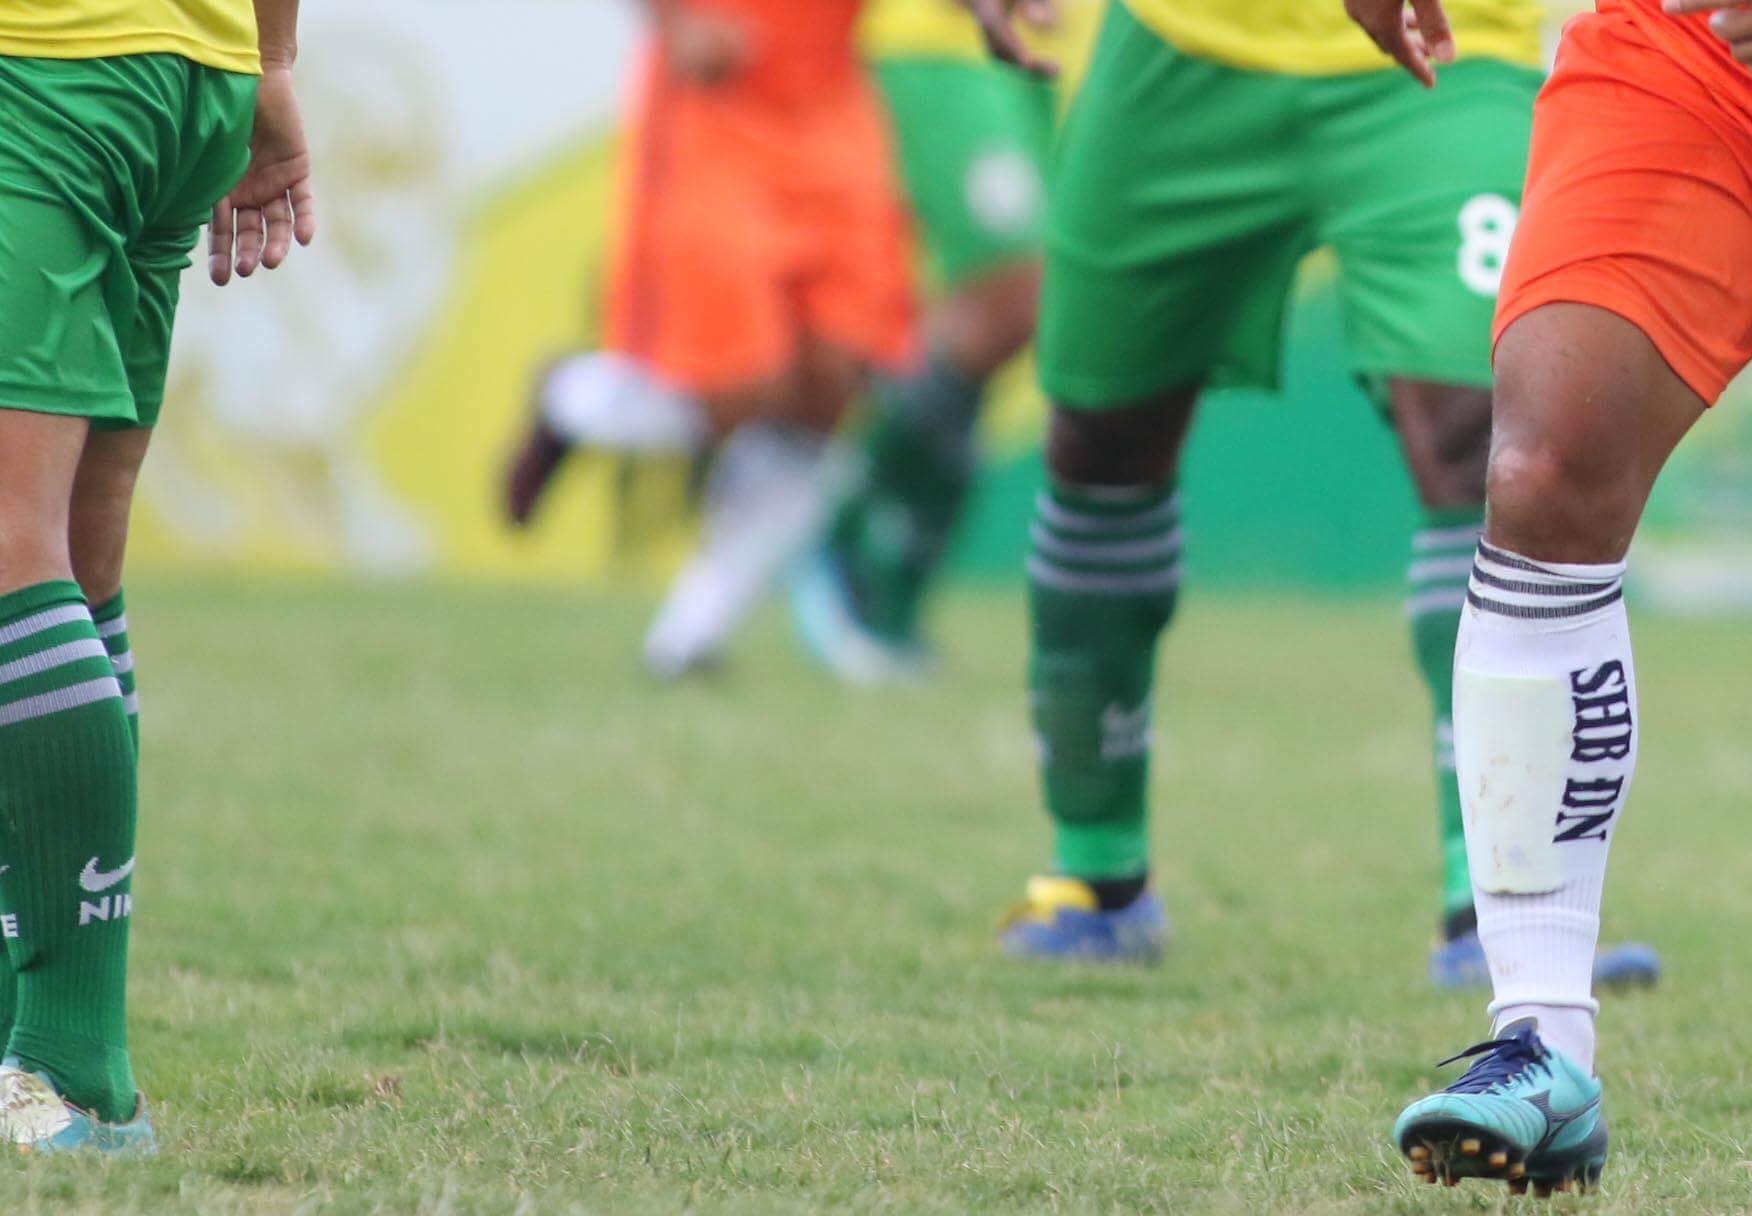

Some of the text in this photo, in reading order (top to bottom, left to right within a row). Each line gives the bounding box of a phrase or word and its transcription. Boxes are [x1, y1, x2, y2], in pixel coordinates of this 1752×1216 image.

[1456, 191, 1519, 297] 8
[1552, 658, 1632, 844] SHB DN
